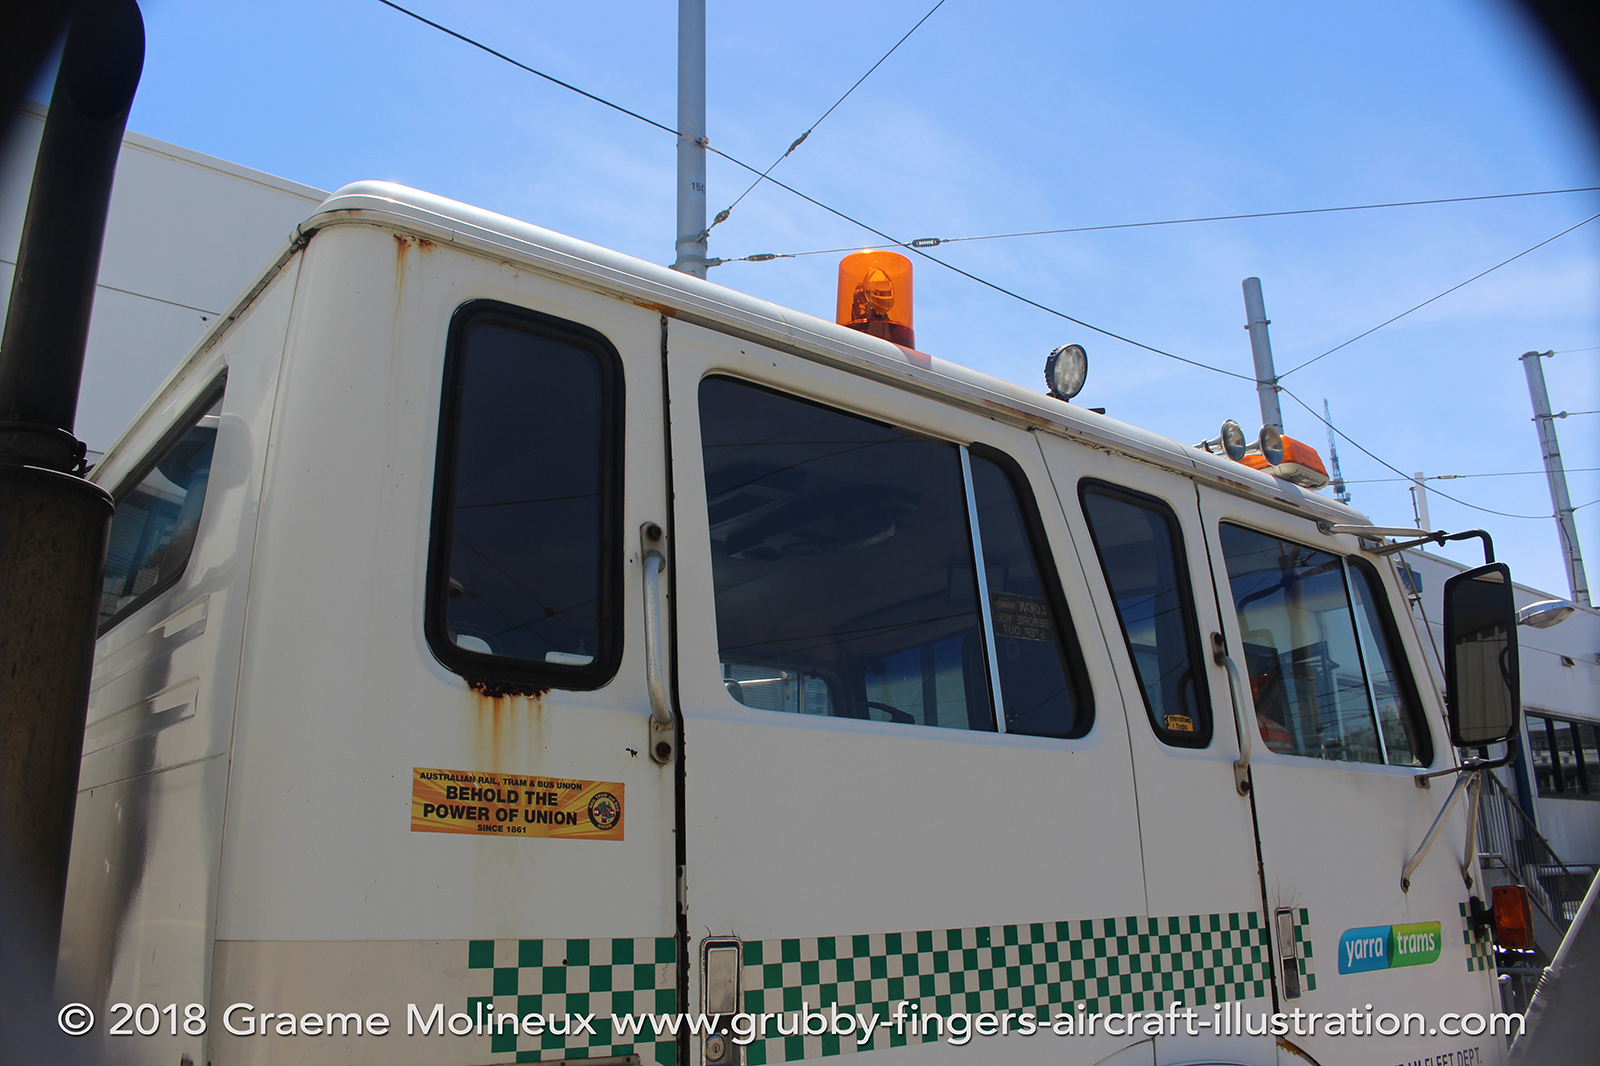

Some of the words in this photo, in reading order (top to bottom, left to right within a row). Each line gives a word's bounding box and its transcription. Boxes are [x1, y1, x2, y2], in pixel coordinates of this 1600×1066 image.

[419, 772, 476, 783] AUSTRALIAN
[478, 776, 500, 786] RAIL,
[503, 778, 527, 787] TRAM
[529, 779, 535, 787] &
[537, 780, 555, 789] BUS
[556, 782, 582, 791] UNION
[446, 785, 519, 804] BEHOLD
[524, 791, 558, 806] THE
[423, 803, 490, 821] POWER
[495, 807, 519, 823] OF
[524, 809, 578, 826] UNION
[477, 824, 504, 833] SINCE
[506, 825, 527, 833] 1861
[1345, 937, 1384, 967] yarra
[1397, 931, 1436, 955] trams
[1456, 1046, 1482, 1066] DEPT.
